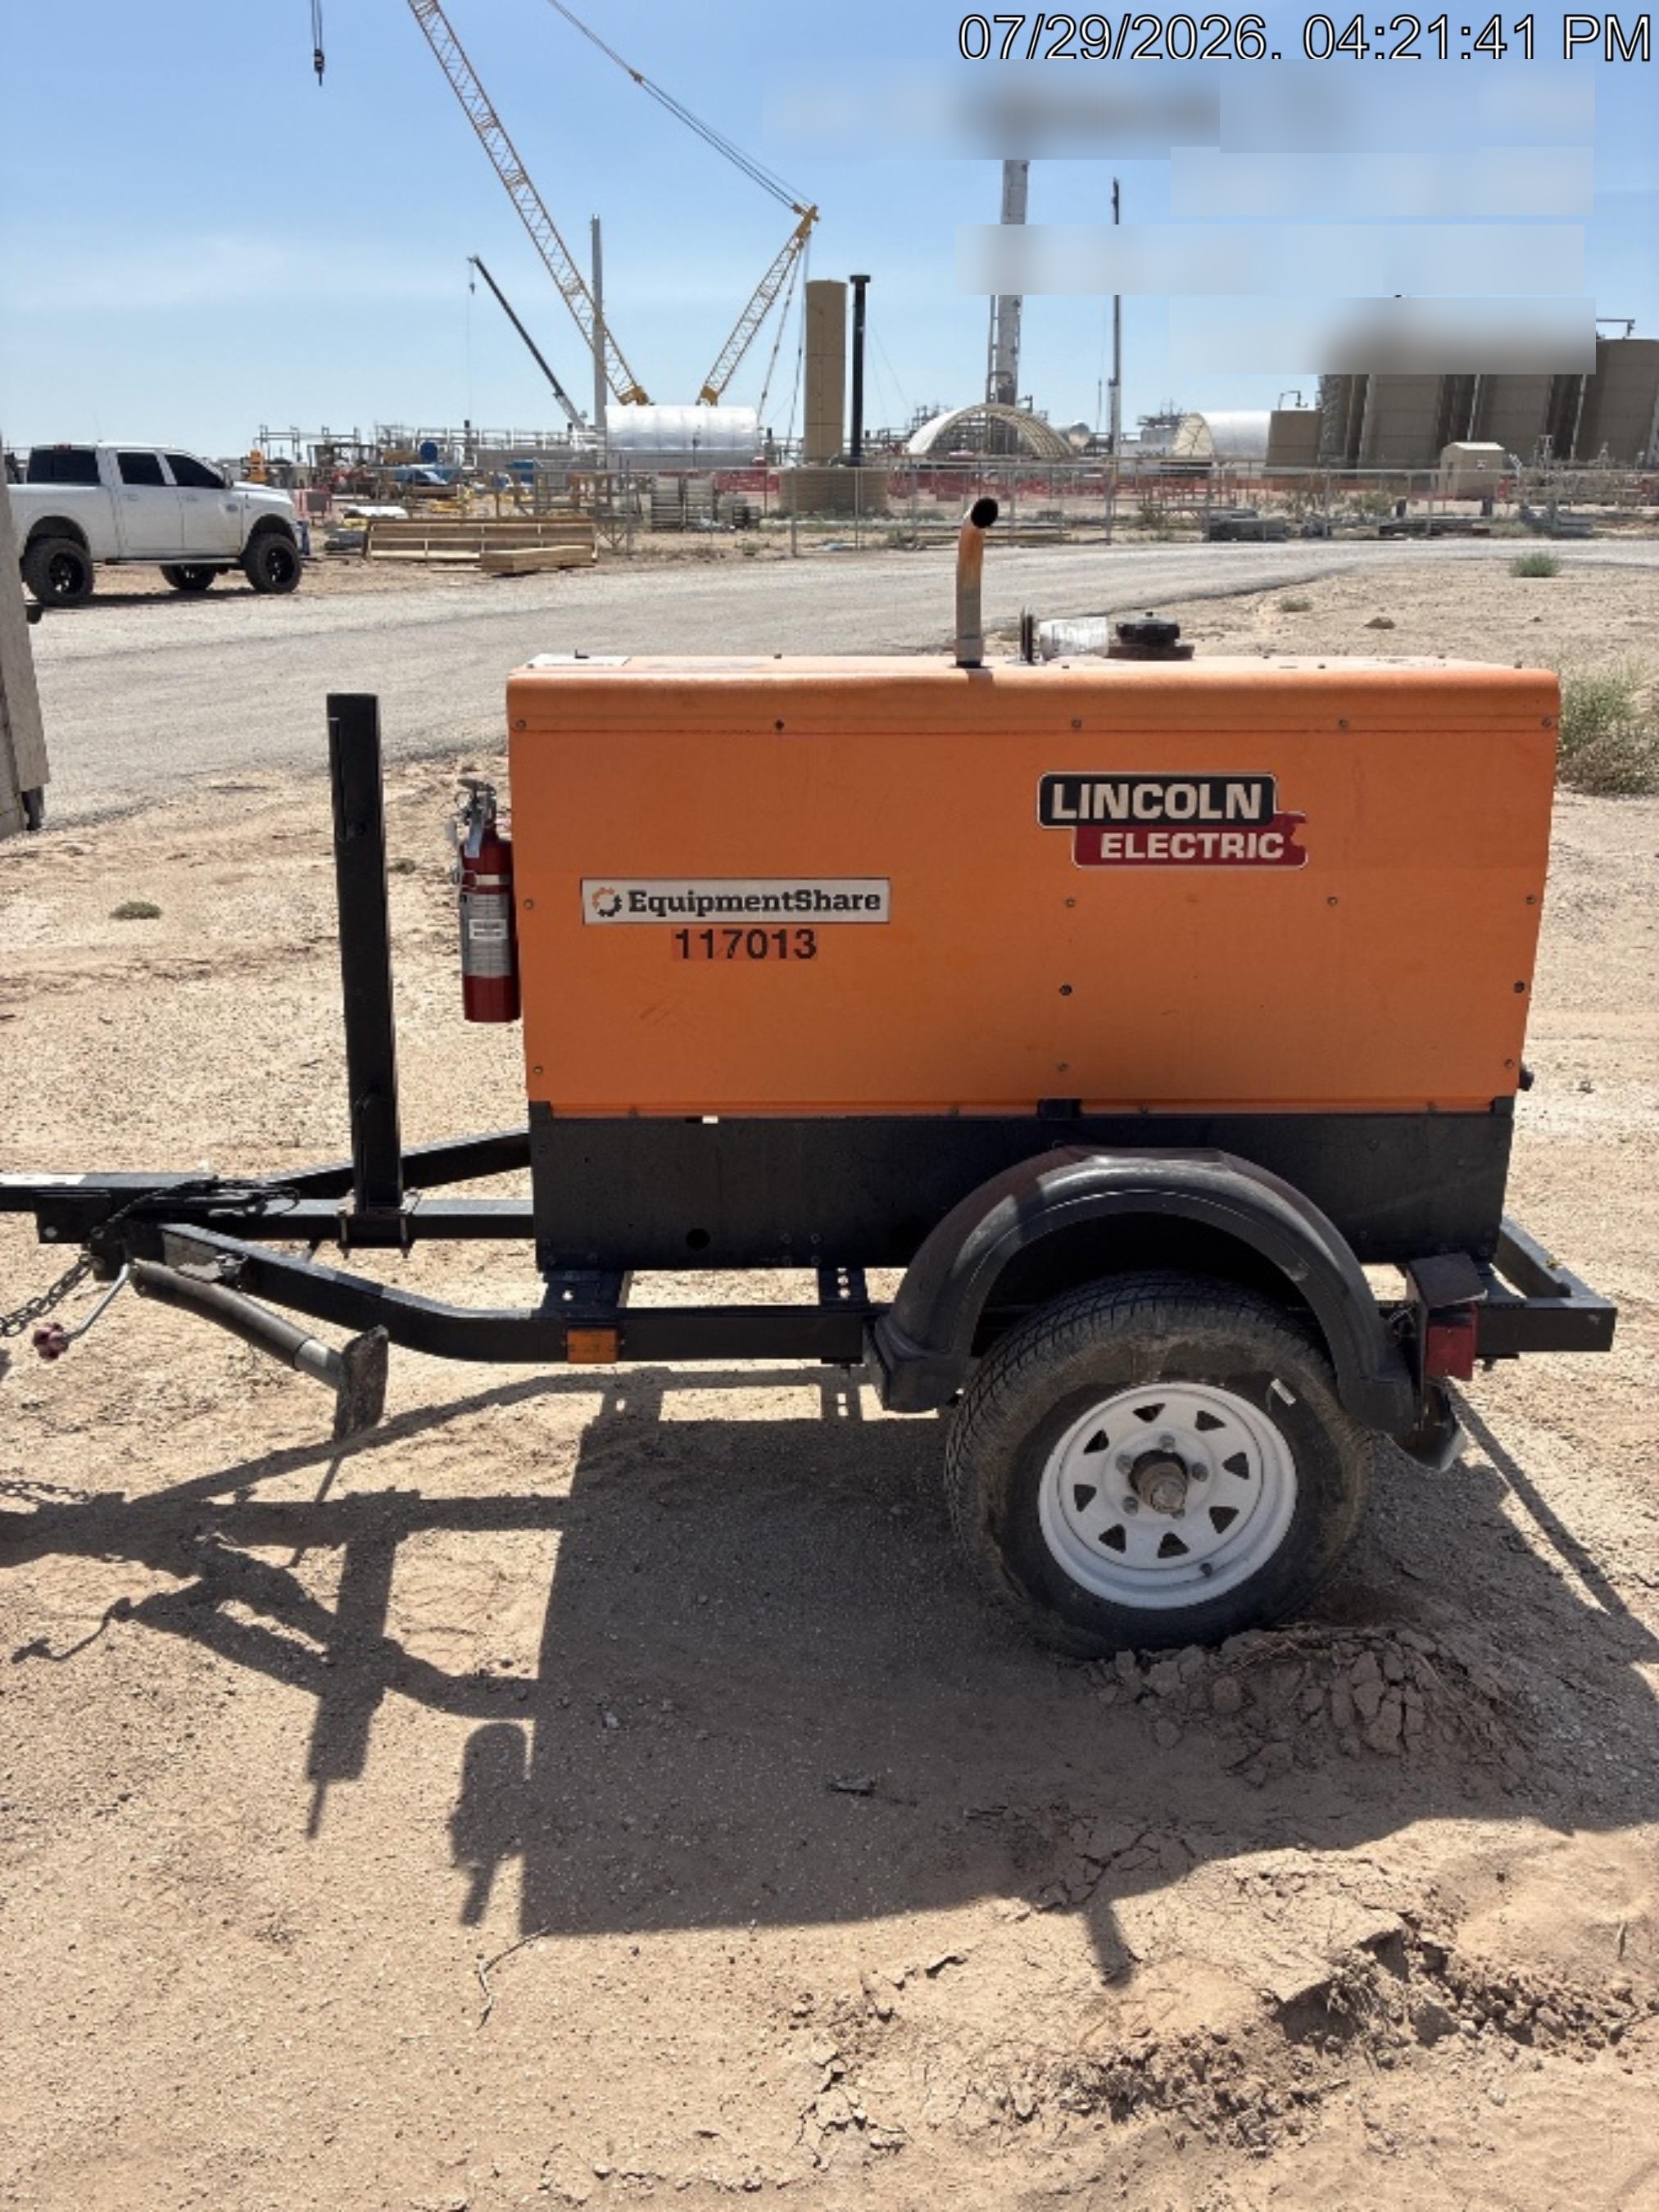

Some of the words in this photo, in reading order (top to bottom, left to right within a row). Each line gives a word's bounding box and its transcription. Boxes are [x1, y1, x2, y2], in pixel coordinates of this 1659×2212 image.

[1051, 783, 1262, 820] LINCOLN
[1100, 832, 1284, 859] ELECTRIC
[628, 890, 881, 917] EquipmentShare
[675, 928, 818, 959] 117013
